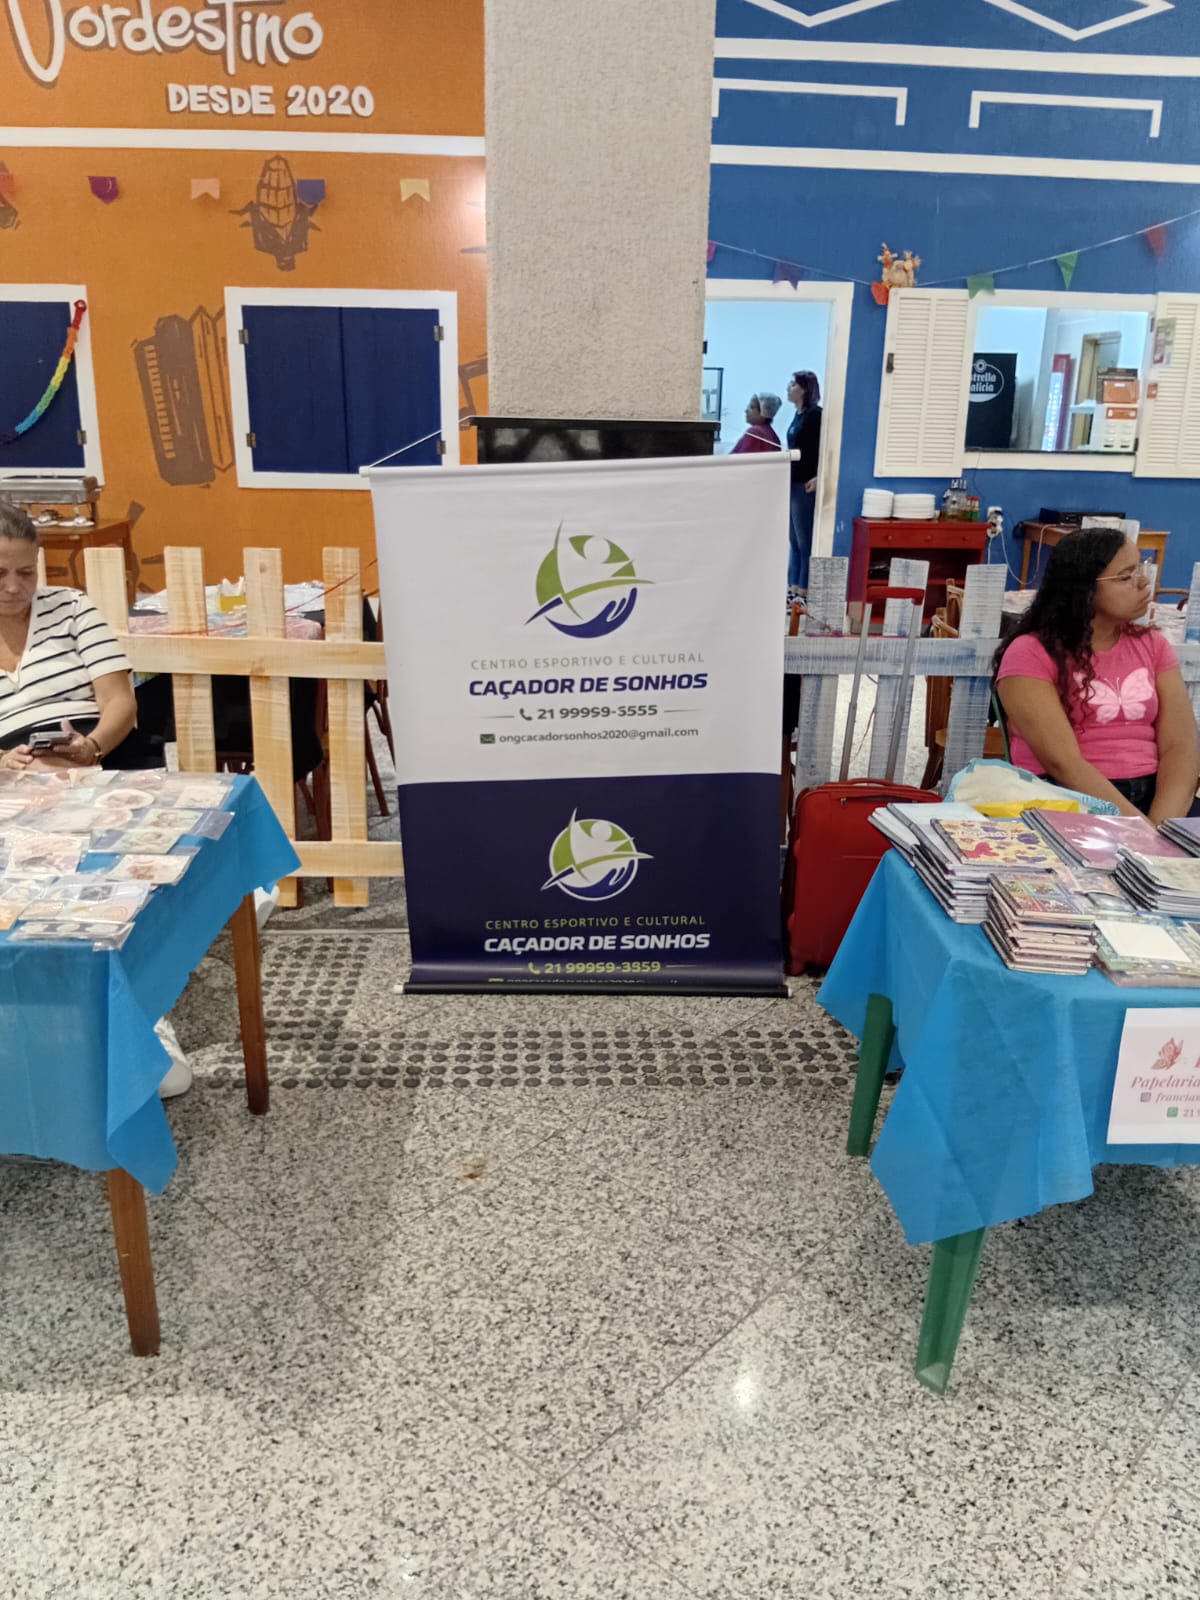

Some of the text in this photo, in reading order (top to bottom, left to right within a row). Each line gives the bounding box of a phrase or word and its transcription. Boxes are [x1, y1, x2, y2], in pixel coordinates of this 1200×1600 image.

[167, 83, 374, 117] DESDE 2020
[470, 652, 706, 671] CENTRO ESPORTIVO E CULTURAL
[469, 673, 708, 699] CAÇADOR DE SONHOS
[537, 708, 555, 720] 21
[485, 915, 706, 930] CENTRO ESPORTIVO E CULTURAL
[484, 933, 711, 955] CAÇADOR DE SONHOS
[544, 963, 561, 974] 21
[1131, 1075, 1200, 1090] Papelaria
